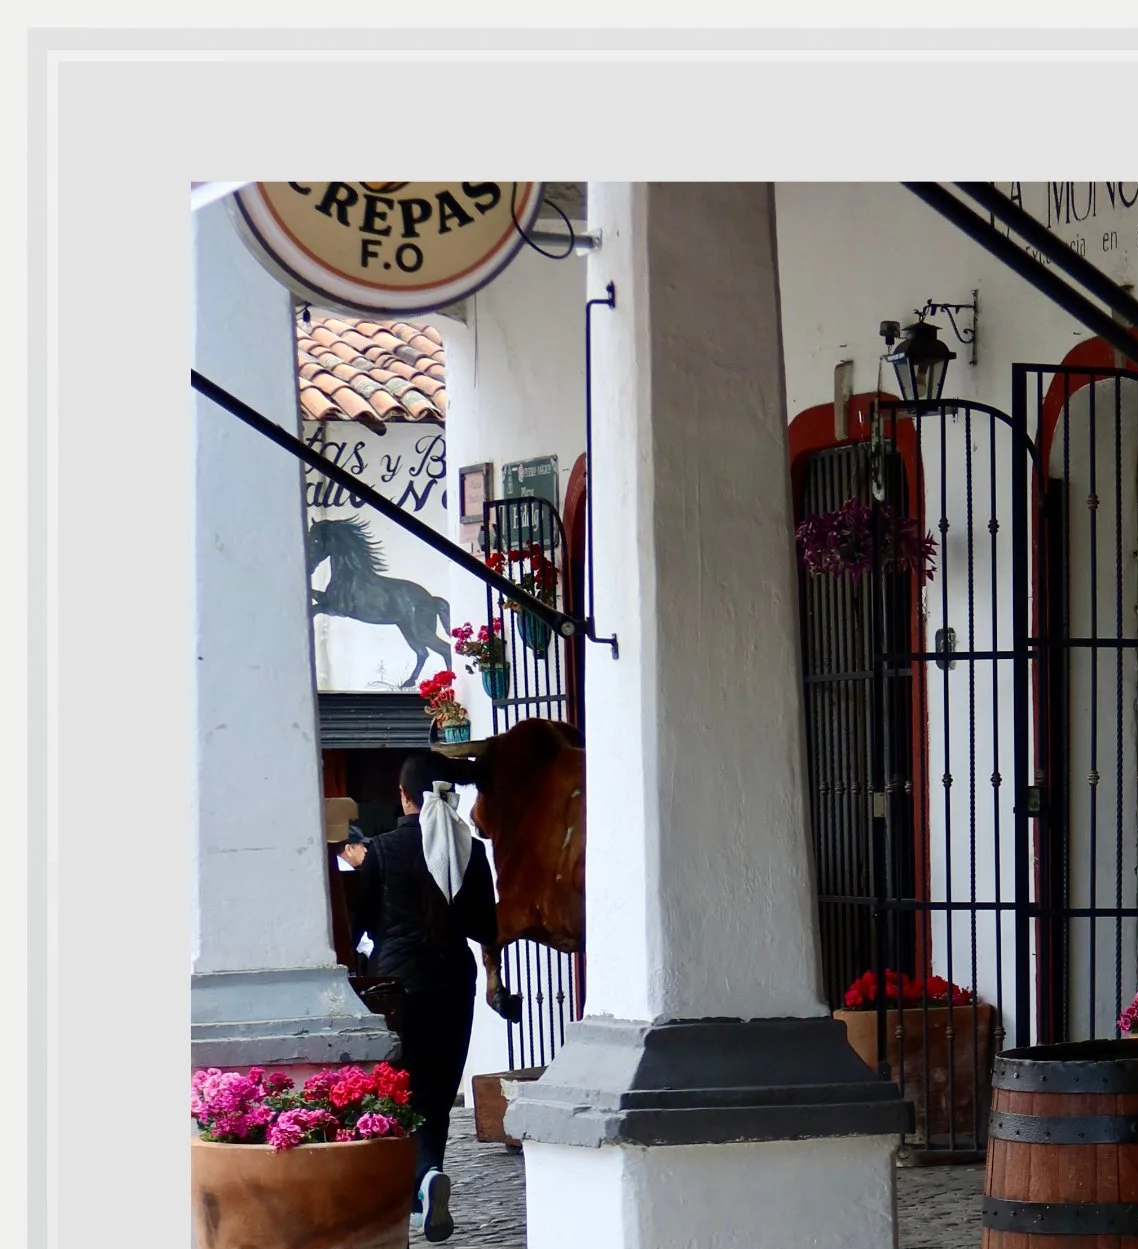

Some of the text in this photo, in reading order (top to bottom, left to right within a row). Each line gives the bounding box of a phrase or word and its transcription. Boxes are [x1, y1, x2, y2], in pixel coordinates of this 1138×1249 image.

[288, 182, 501, 238] REPAS
[1102, 230, 1118, 252] en
[380, 454, 403, 482] y
